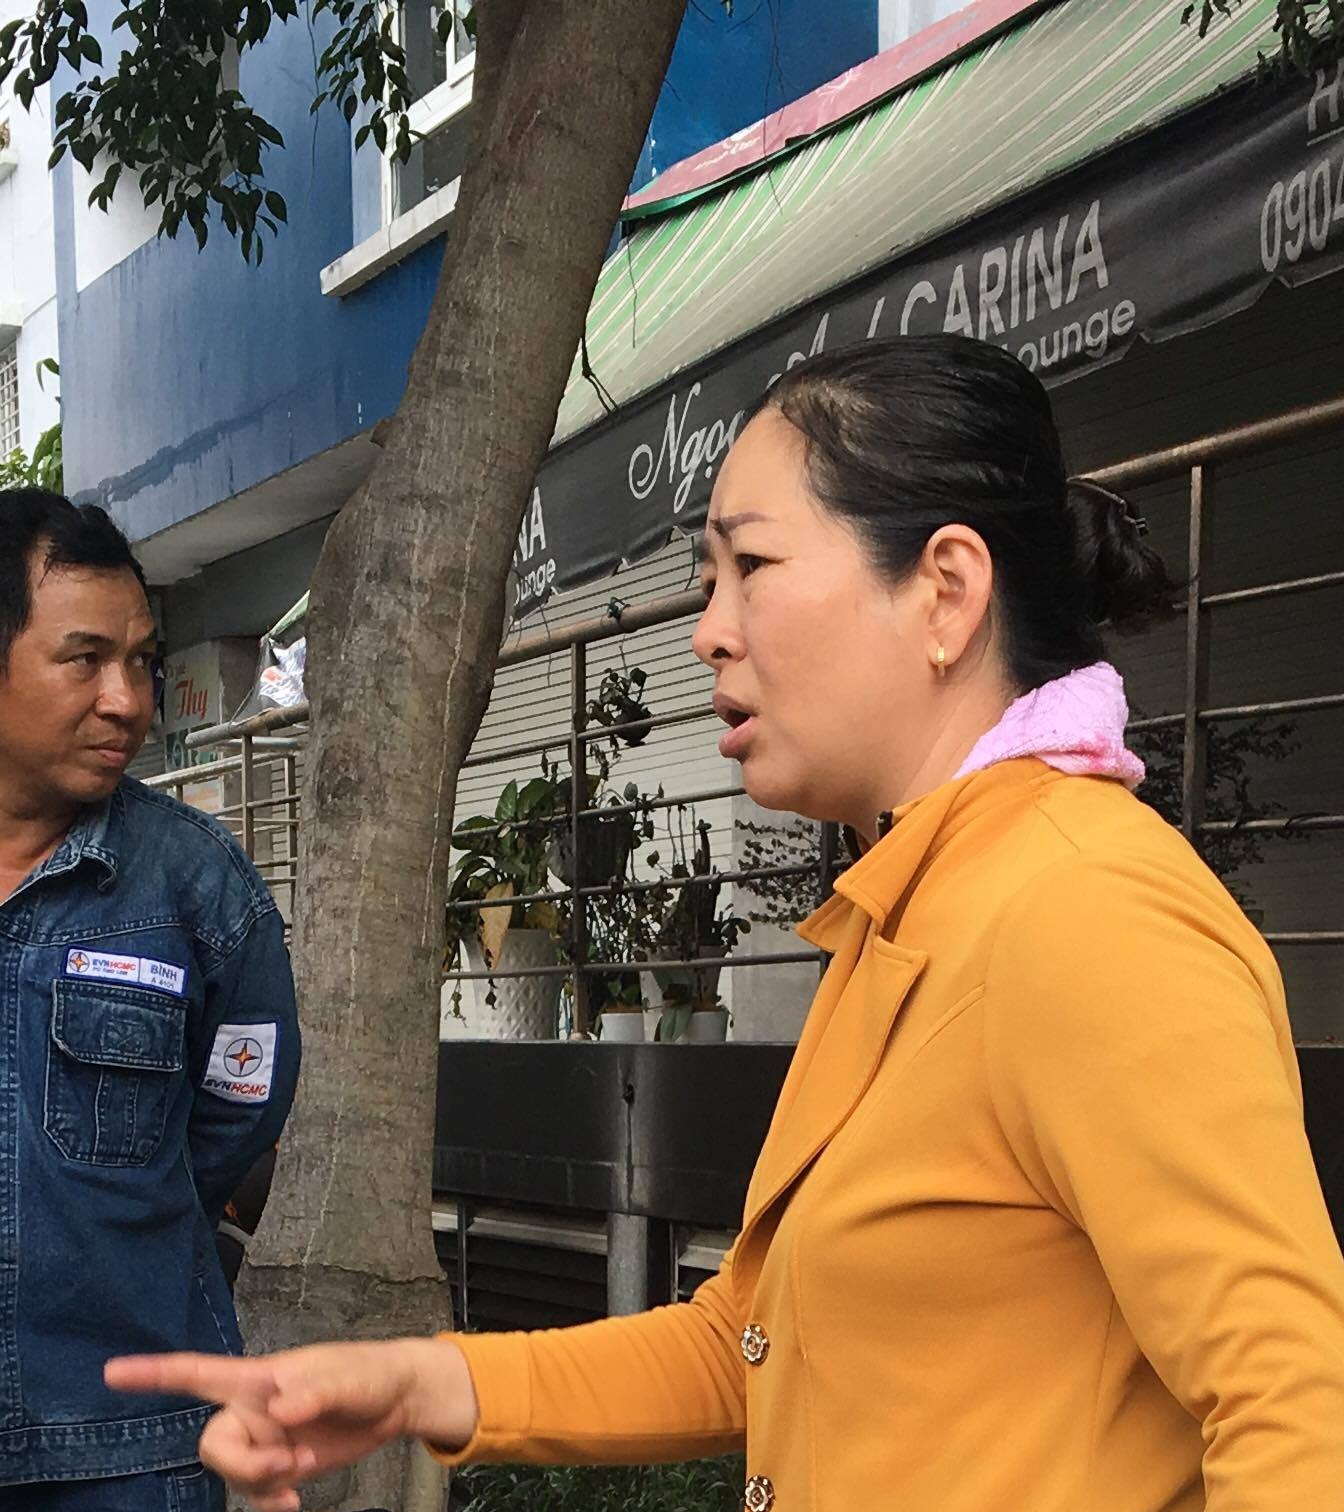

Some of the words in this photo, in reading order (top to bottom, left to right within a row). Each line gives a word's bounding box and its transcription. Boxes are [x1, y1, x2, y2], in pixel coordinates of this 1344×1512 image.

[900, 199, 1109, 341] CARINA
[1001, 299, 1136, 372] ounge
[516, 558, 557, 605] unge
